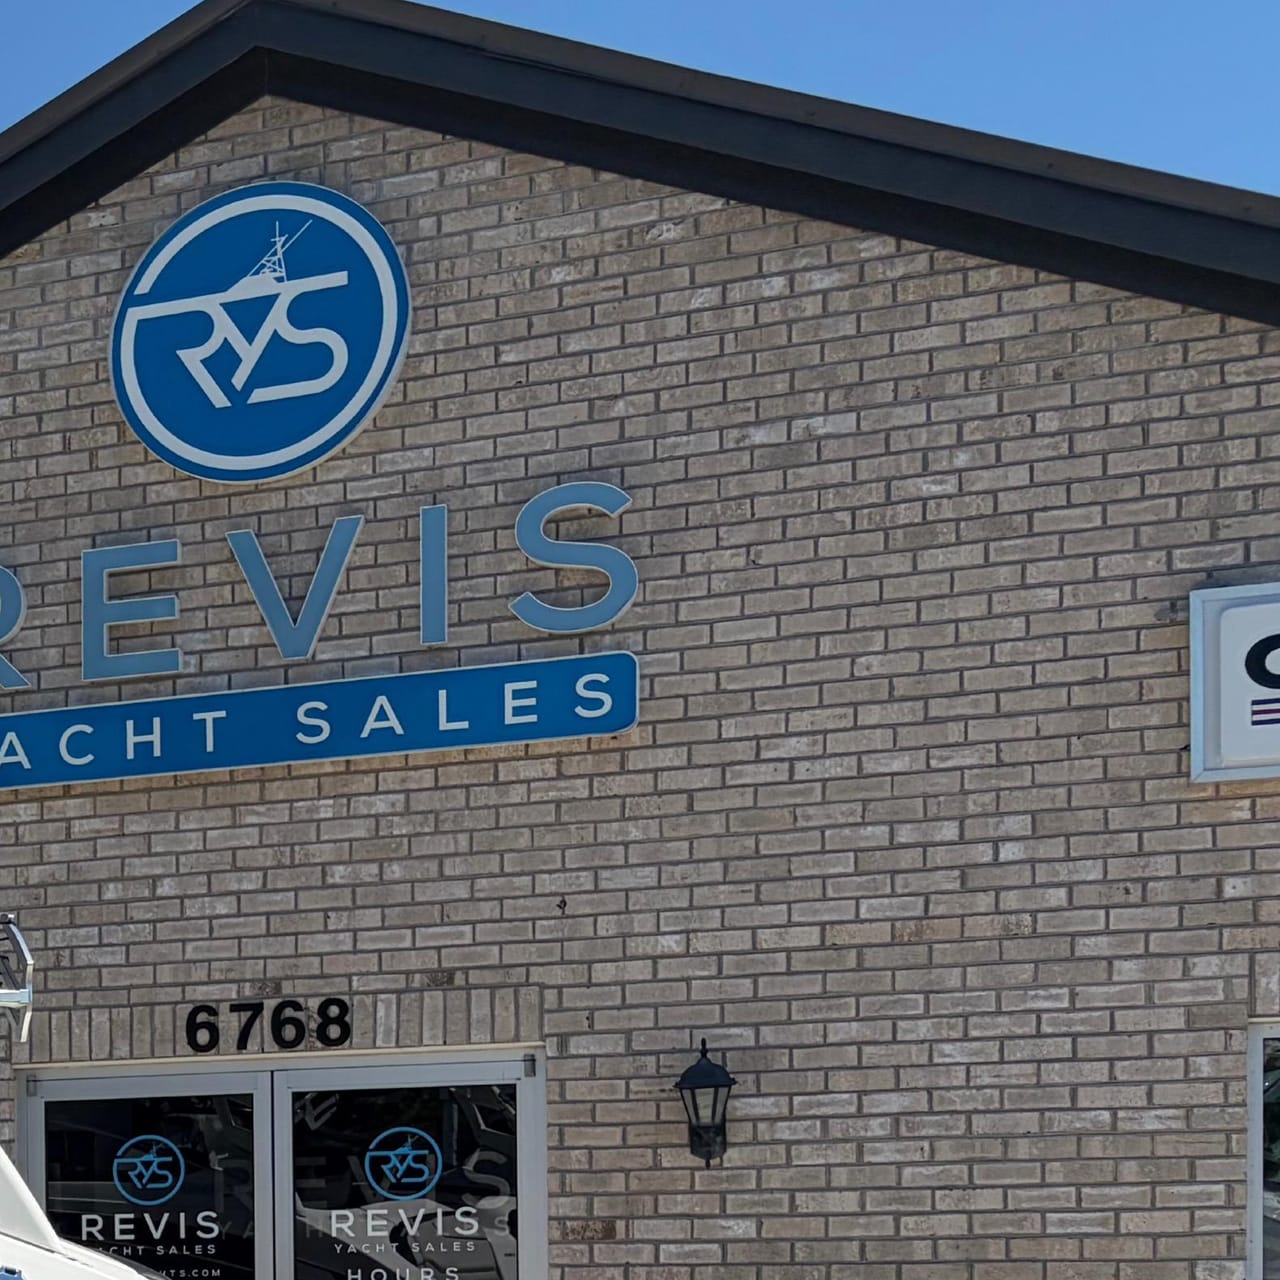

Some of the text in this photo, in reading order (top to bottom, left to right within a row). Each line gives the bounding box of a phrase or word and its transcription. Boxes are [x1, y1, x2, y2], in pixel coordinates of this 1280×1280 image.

[295, 673, 613, 744] SALES
[185, 998, 351, 1052] 6768
[81, 1210, 220, 1241] REVIS
[331, 1206, 479, 1238] REVIS
[156, 1244, 216, 1255] SALES
[334, 1241, 476, 1254] YACHT SALES
